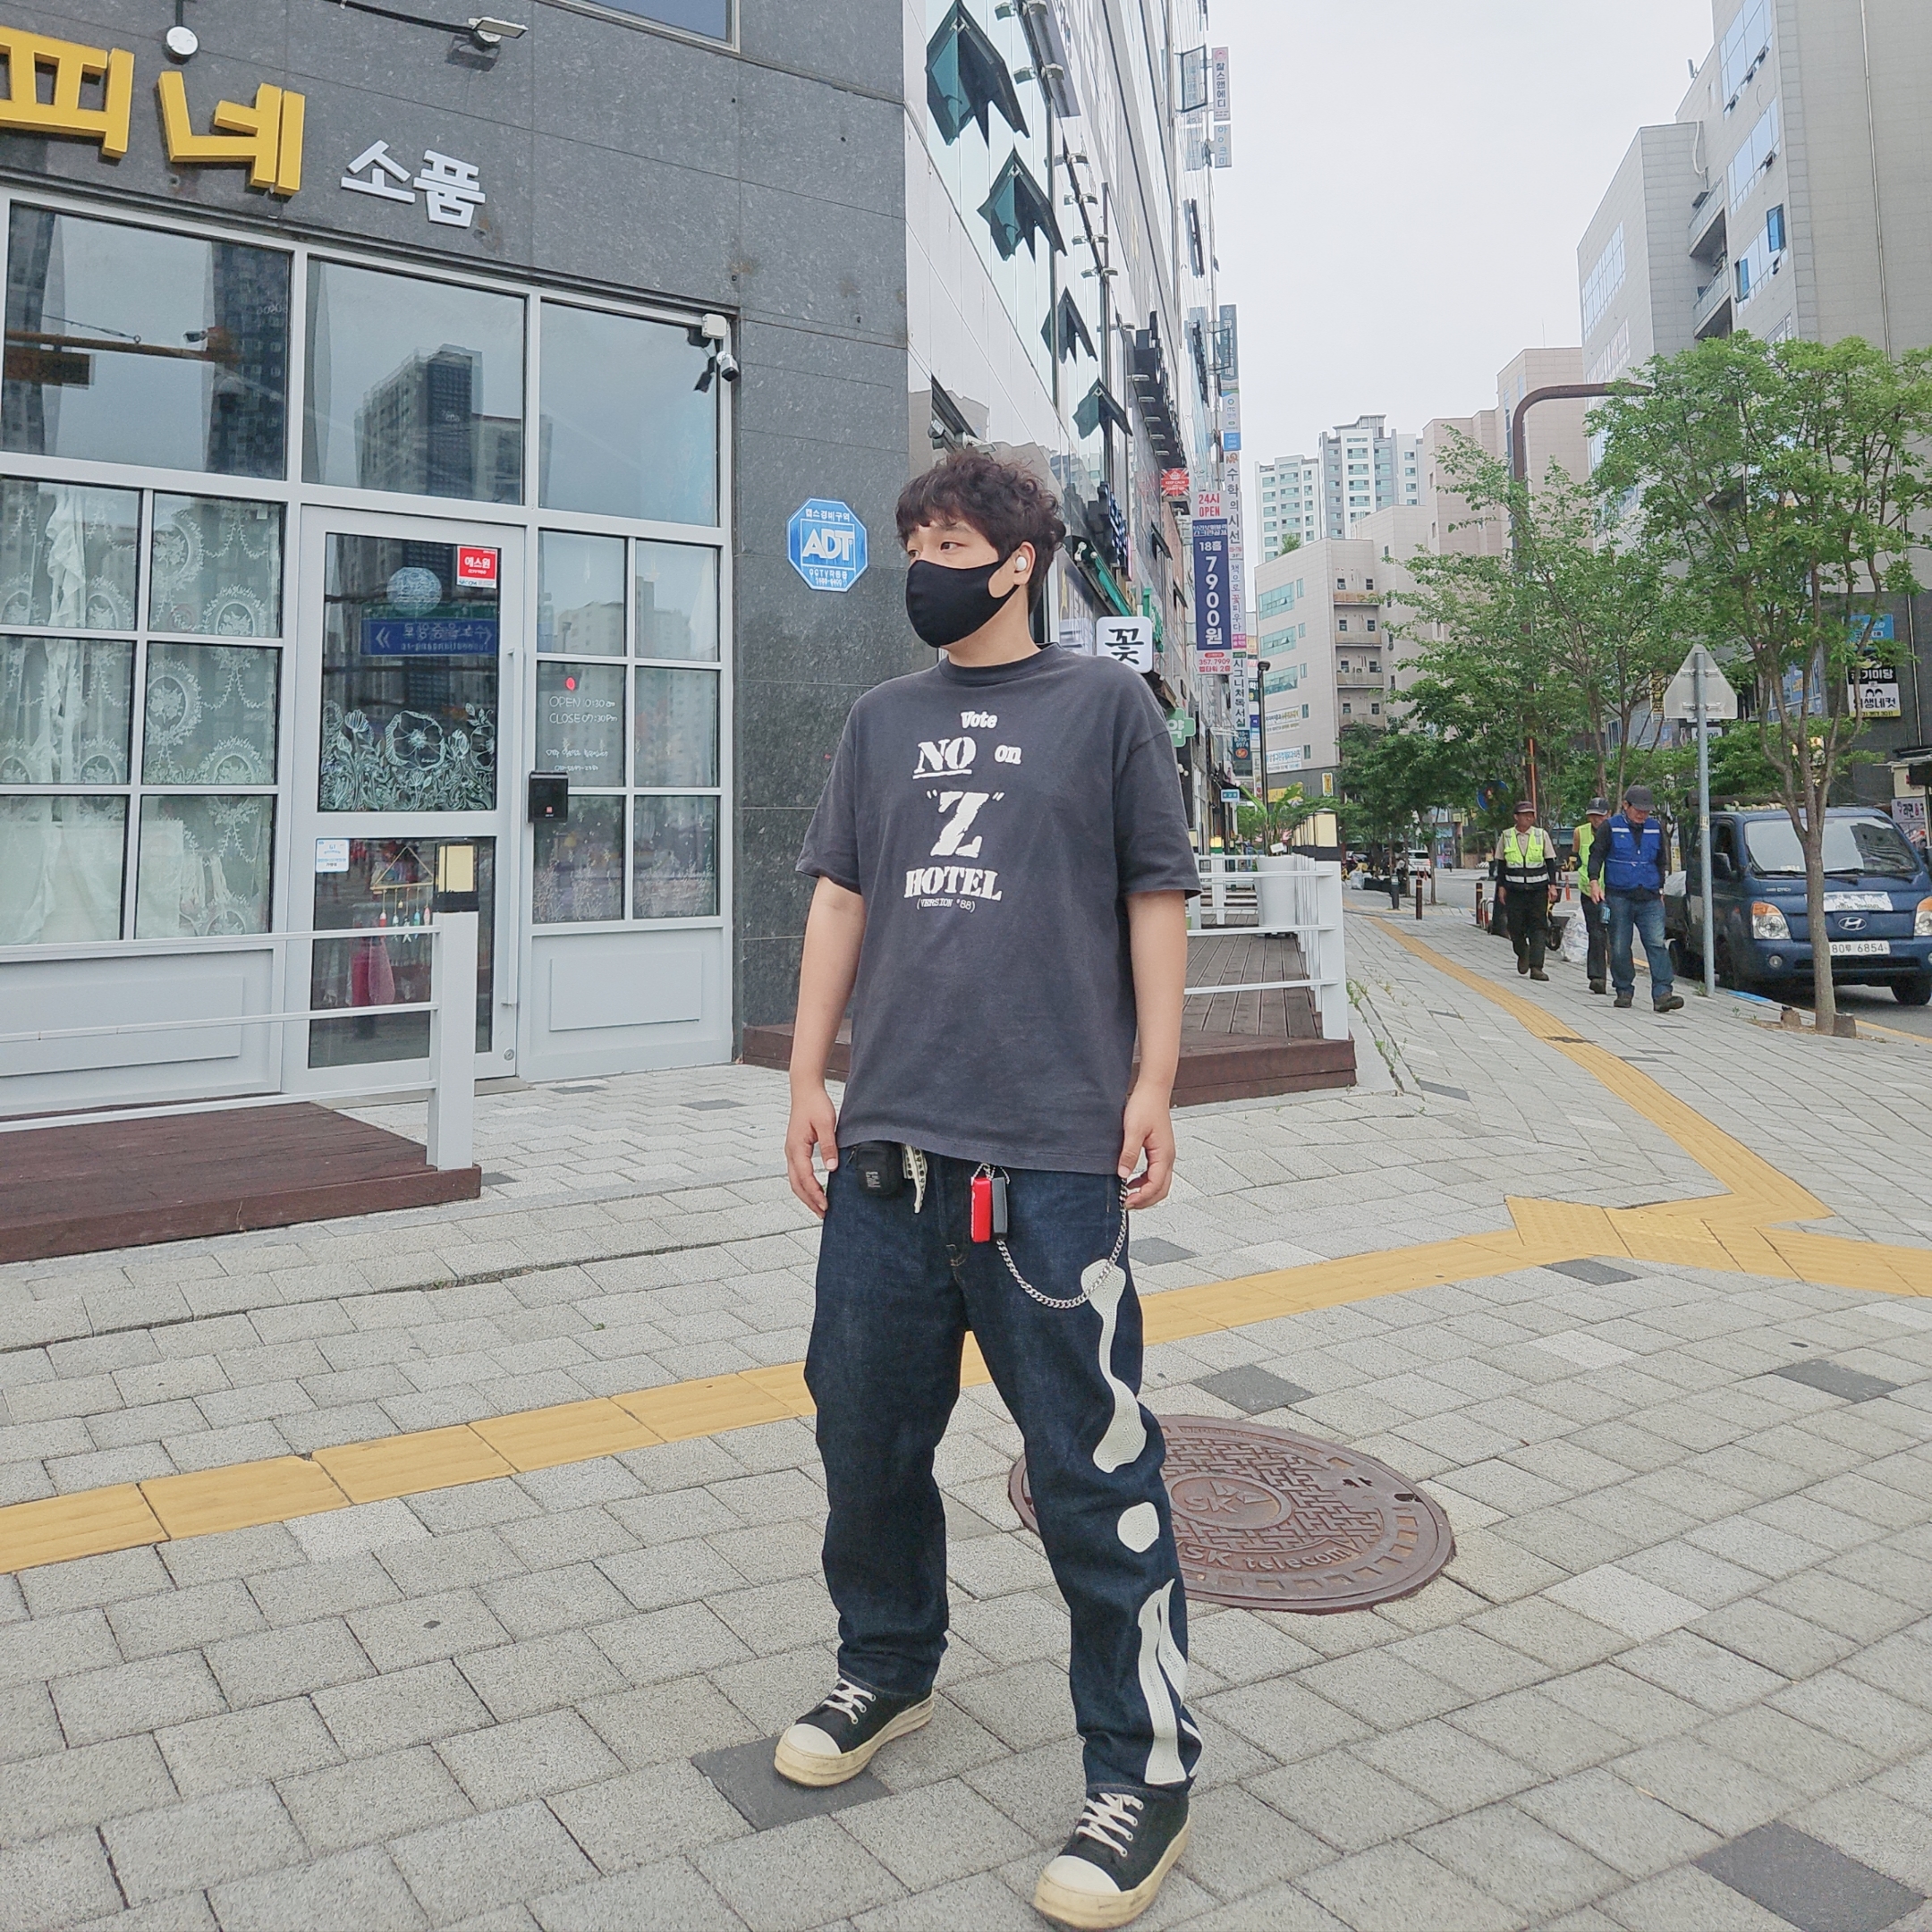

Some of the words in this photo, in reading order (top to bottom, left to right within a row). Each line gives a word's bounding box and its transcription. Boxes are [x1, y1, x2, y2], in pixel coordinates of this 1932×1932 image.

[340, 140, 486, 227] 소품
[1199, 494, 1220, 504] 24시
[1199, 506, 1220, 517] OPEN
[802, 528, 854, 562] ADT
[1199, 540, 1222, 552] 18홀
[464, 555, 491, 569] 에스원
[1204, 555, 1224, 645] 7900원
[1105, 628, 1144, 665] 꽃
[1852, 668, 1894, 680] 기미당
[549, 696, 580, 708] OPEN
[549, 713, 580, 724] CLOSE
[961, 711, 998, 729] Vote
[1168, 719, 1185, 739] 약
[913, 736, 977, 774] NO
[995, 745, 1021, 765] on
[903, 866, 1003, 902] HOTEL
[916, 897, 953, 911] (VERSION
[1857, 943, 1885, 953] 6854
[1184, 1496, 1240, 1513] SK
[1182, 1545, 1233, 1566] SK
[1243, 1546, 1353, 1572] telecom
